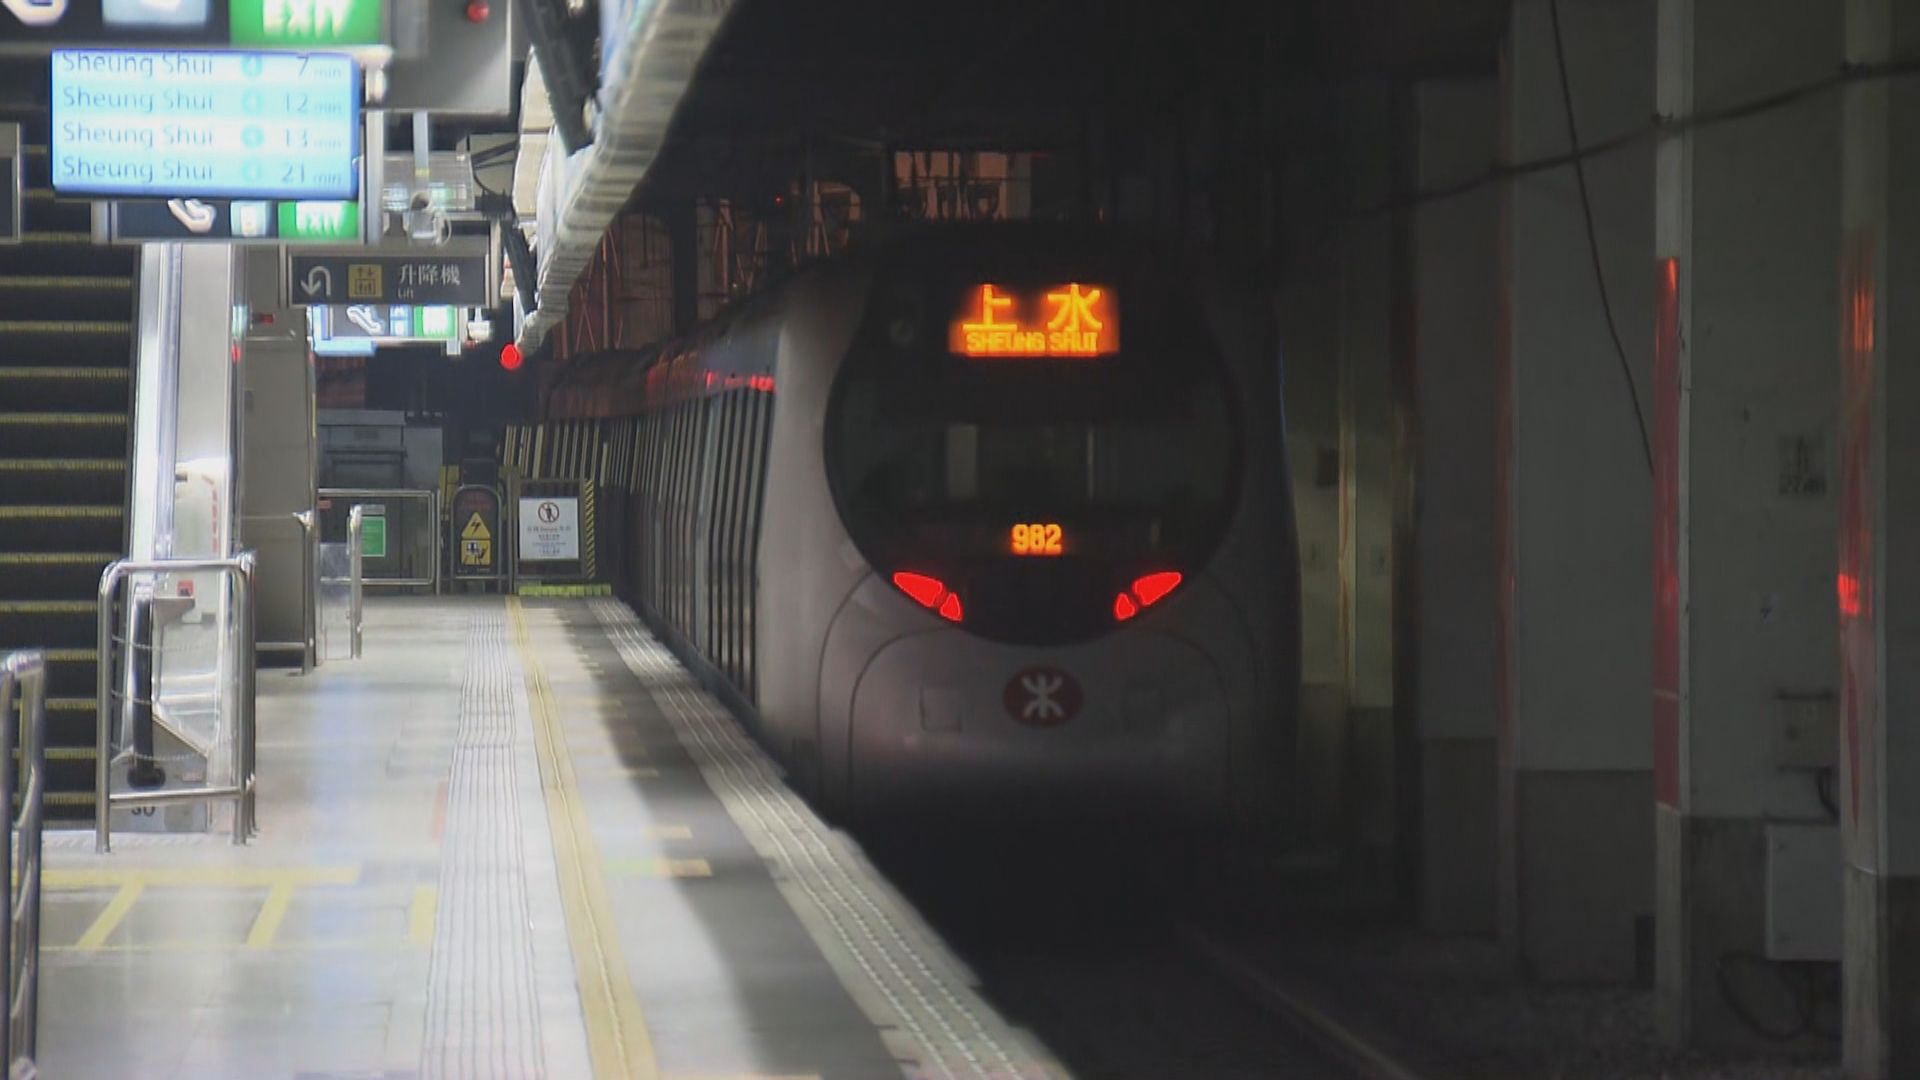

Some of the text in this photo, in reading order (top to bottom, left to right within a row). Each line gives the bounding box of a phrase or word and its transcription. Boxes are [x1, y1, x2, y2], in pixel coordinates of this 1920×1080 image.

[62, 53, 153, 77] Sheung
[162, 53, 213, 73] Shui
[296, 56, 310, 76] 7
[62, 87, 153, 112] Sheung
[162, 87, 213, 108] Shui
[286, 94, 309, 113] 12
[62, 122, 153, 148] Sheung
[162, 122, 213, 144] Shui
[286, 129, 309, 148] 13
[62, 157, 153, 184] Sheung
[162, 157, 213, 180] Shui
[281, 162, 306, 182] 21
[400, 264, 461, 286] 升降機
[962, 283, 1103, 332] 上水
[965, 331, 1098, 352] SHEUNG SHUI
[1011, 523, 1062, 554] 982
